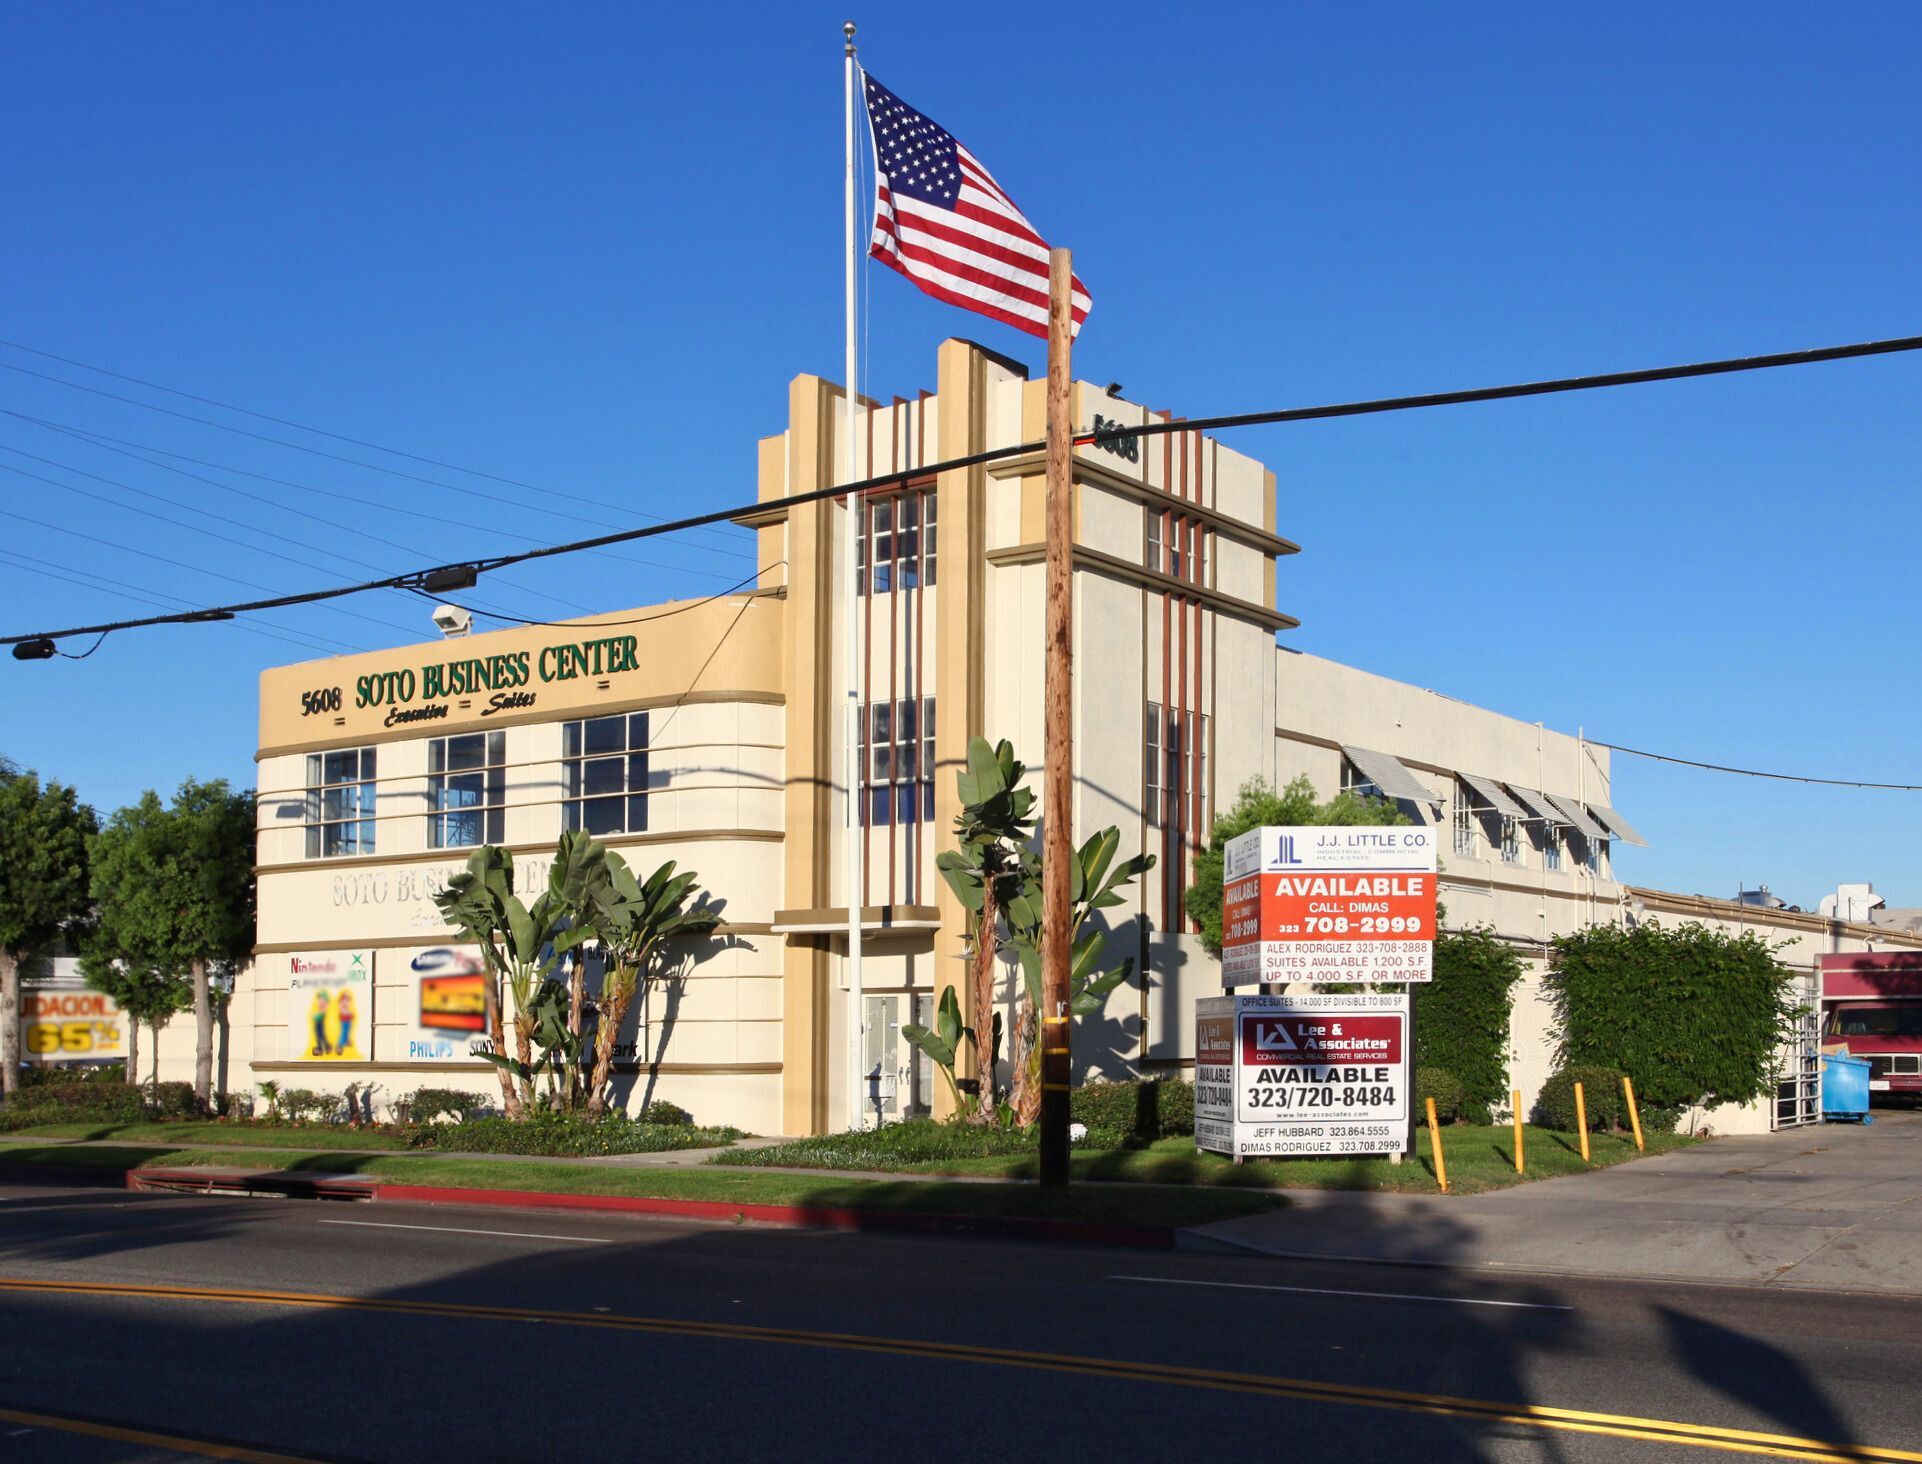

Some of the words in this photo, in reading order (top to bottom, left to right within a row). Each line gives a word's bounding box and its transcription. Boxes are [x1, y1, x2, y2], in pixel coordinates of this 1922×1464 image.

[301, 687, 343, 716] 5608
[355, 668, 416, 709] SOTO
[422, 651, 530, 700] BUSINESS
[538, 635, 641, 683] CENTER
[383, 703, 449, 728] Executive
[480, 691, 537, 717] Suites
[1316, 834, 1341, 847] J.J.
[1347, 834, 1397, 847] LITTLE
[1403, 834, 1430, 847] CO.
[333, 872, 389, 907] SOTO
[397, 866, 464, 902] BUSIN
[1227, 879, 1259, 906] AVAILABLE
[1275, 878, 1424, 897] AVAILABLE
[1309, 902, 1345, 913] CALL:
[1349, 902, 1389, 913] DIMAS
[1279, 925, 1300, 933] 323
[1304, 916, 1422, 933] 708-2999
[1266, 943, 1291, 953] ALEX
[1295, 943, 1352, 953] RODRIGUEZ
[1356, 943, 1427, 953] 323-708-2888
[1266, 957, 1306, 967] SUITES
[1311, 957, 1369, 967] AVAILABLE
[1407, 956, 1428, 967] S.F.
[1266, 971, 1282, 981] UP
[1287, 971, 1301, 981] TO
[1371, 970, 1388, 980] OR
[1393, 969, 1427, 980] MORE
[1242, 998, 1267, 1007] OFFICE
[1269, 998, 1294, 1007] SUITES
[1323, 998, 1332, 1007] SF
[1334, 998, 1366, 1006] DIVISIBLE
[1368, 997, 1378, 1006] TO
[1379, 997, 1392, 1006] 800
[1393, 997, 1402, 1006] SF
[1298, 1024, 1326, 1036] Lee
[1331, 1024, 1343, 1036] &
[469, 1039, 495, 1057] SONY
[1353, 1052, 1388, 1060] SERVICES
[1199, 1067, 1231, 1084] AVAILABLE
[1256, 1067, 1389, 1084] AVAILABLE
[1247, 1086, 1396, 1110] 323/720-8484
[1253, 1128, 1275, 1138] JEFF
[1278, 1127, 1324, 1137] HUBBARD
[1329, 1126, 1390, 1137] 323.864.5555
[1240, 1143, 1272, 1153] DIMAS
[1275, 1142, 1331, 1152] RODRIGUEZ
[1339, 1140, 1401, 1151] 323.708.2999
